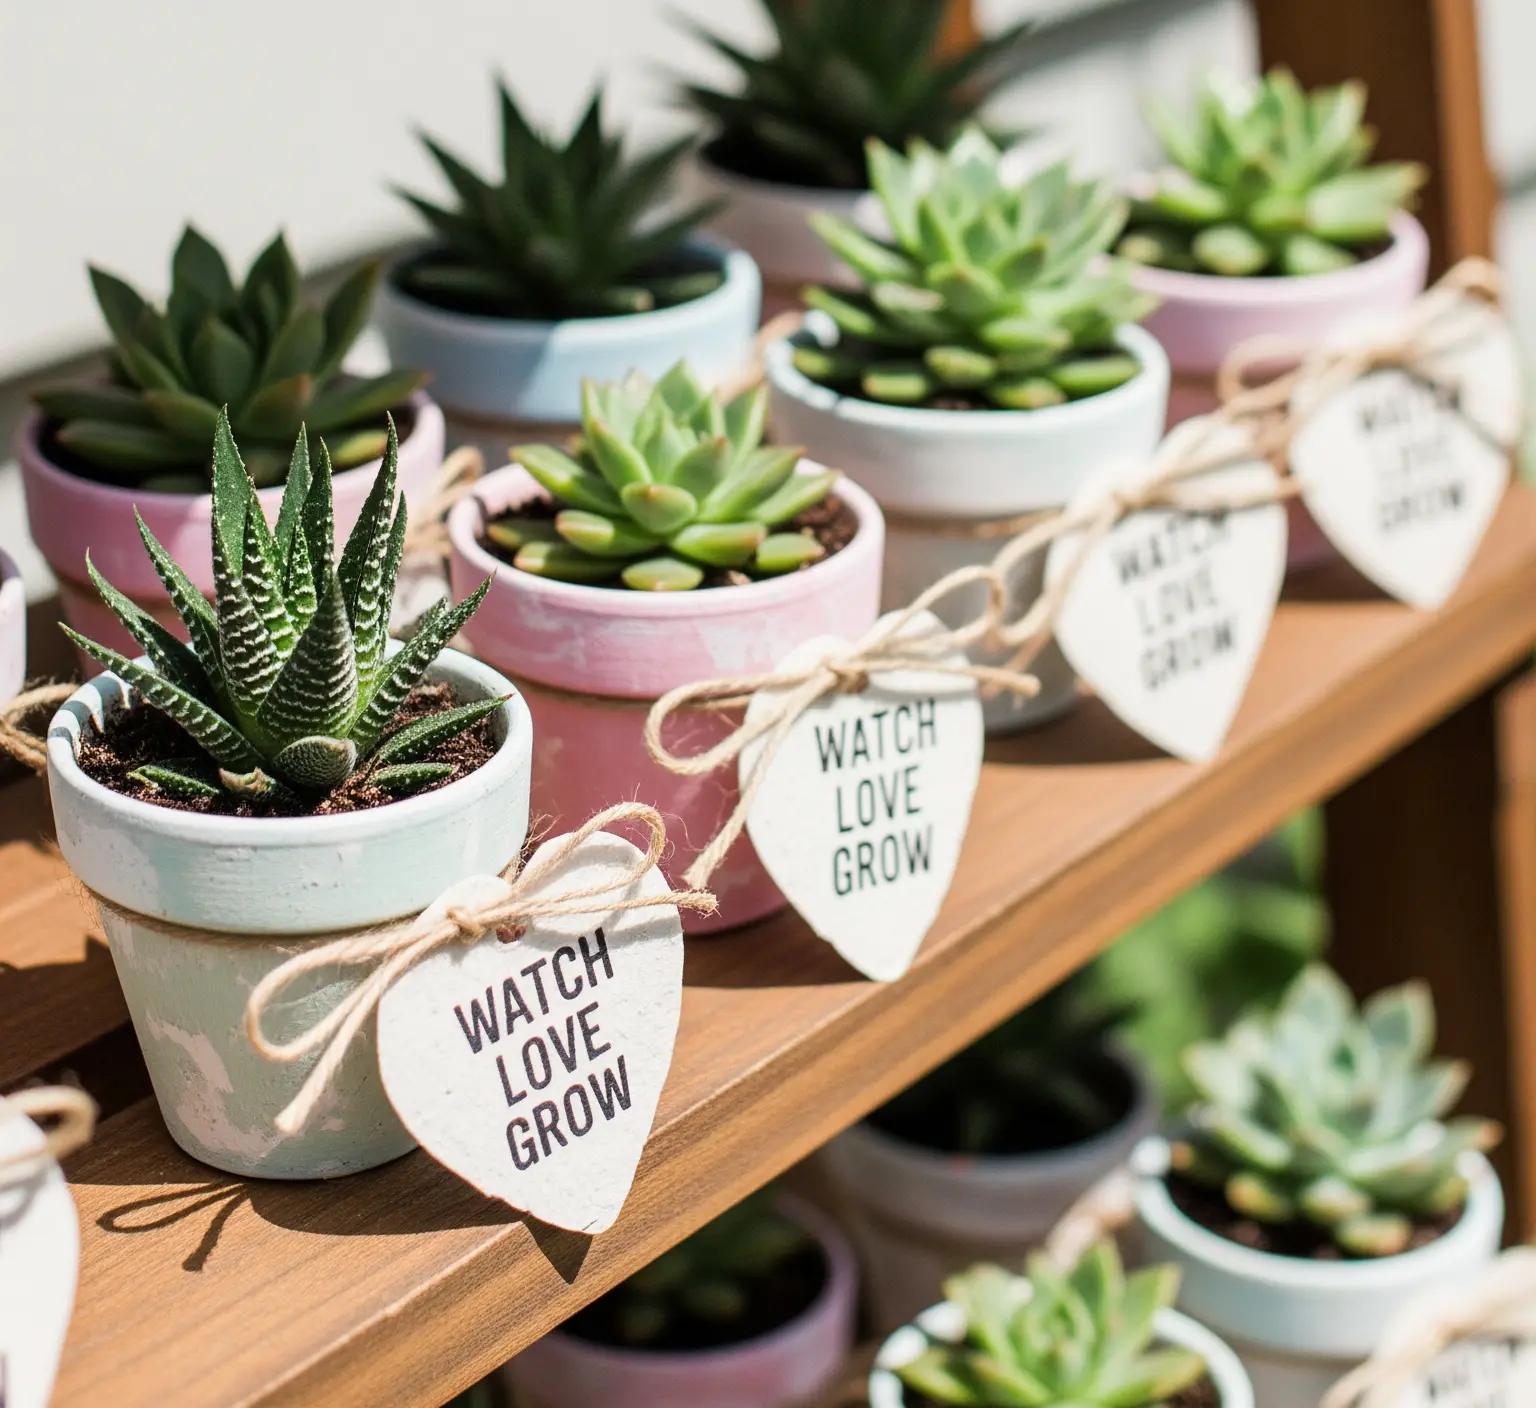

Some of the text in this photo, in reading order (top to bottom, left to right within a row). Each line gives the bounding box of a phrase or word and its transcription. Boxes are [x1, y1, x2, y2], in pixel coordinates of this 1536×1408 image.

[814, 696, 937, 774] WATCH
[836, 764, 921, 834] LOVE
[833, 823, 932, 897] GROW
[453, 926, 614, 1055] WATCH
[495, 1000, 612, 1108] LOVE
[505, 1054, 632, 1172] GROW
